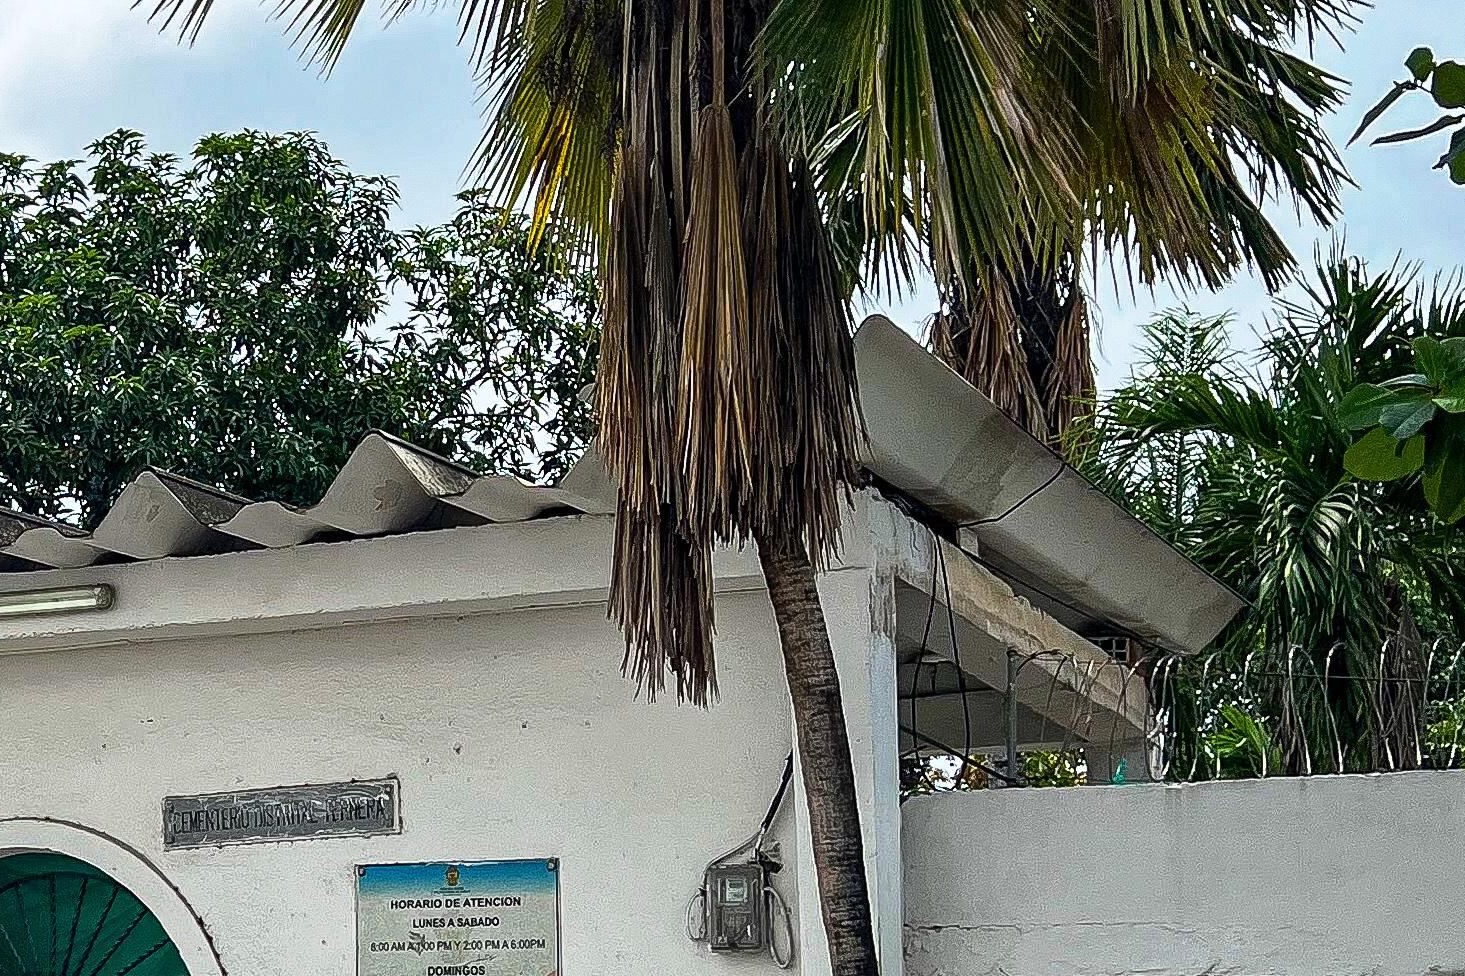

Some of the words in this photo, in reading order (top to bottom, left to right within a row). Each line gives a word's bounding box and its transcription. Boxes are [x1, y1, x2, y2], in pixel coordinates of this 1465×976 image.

[173, 805, 249, 834] CEMENTERIO
[390, 899, 442, 910] HORARIO
[445, 898, 461, 908] DE
[463, 897, 521, 908] ATENCION
[413, 918, 445, 928] LUNES
[447, 918, 456, 927] A
[457, 917, 499, 927] SABADO
[391, 942, 405, 951] AM
[437, 941, 452, 951] PM
[454, 941, 461, 950] Y
[463, 940, 482, 950] 2:00
[485, 940, 500, 949] PM
[502, 940, 509, 949] A
[428, 966, 485, 976] DOMINGOS
